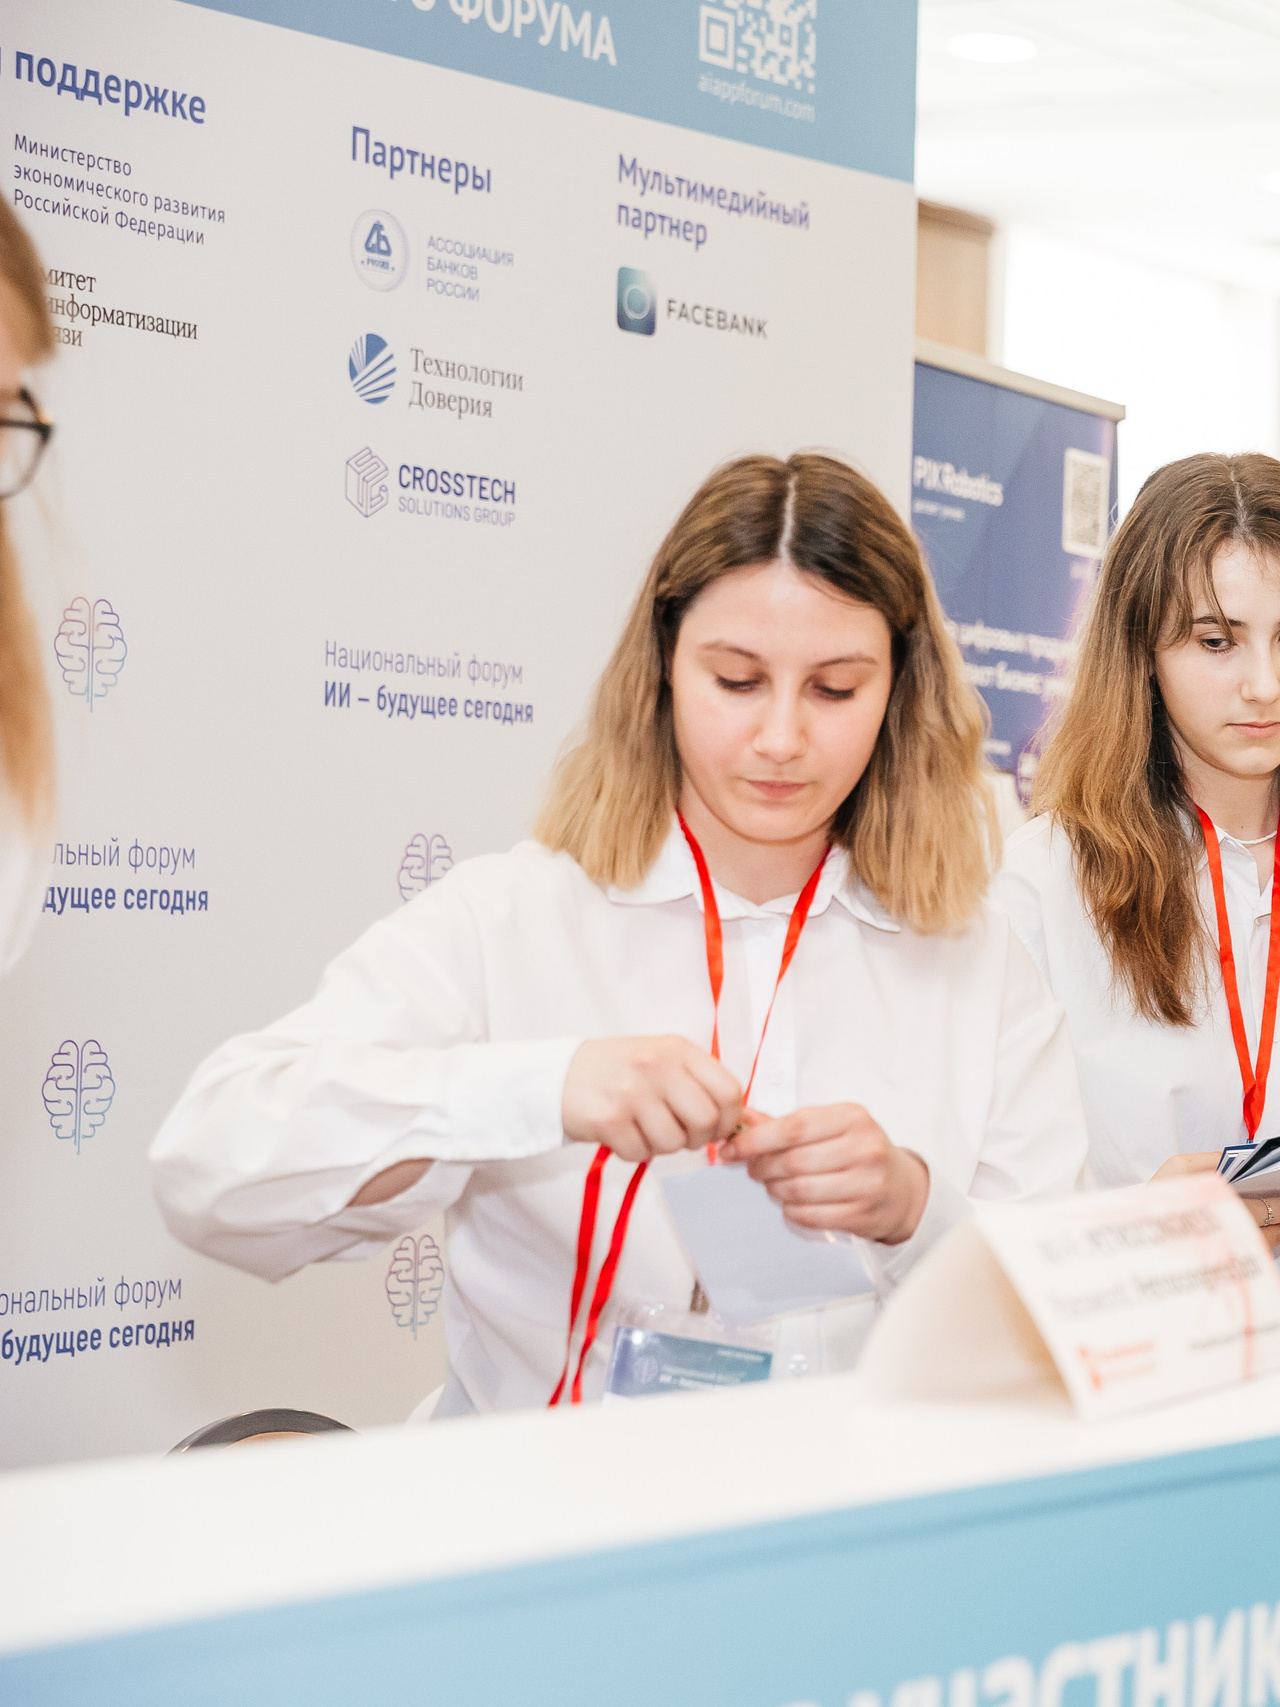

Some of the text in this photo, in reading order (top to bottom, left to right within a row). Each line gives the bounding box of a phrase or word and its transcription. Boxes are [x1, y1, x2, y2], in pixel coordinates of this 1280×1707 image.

[15, 50, 206, 125] поддержке
[13, 133, 132, 176] Министерство
[351, 125, 491, 195] Партнеры
[13, 164, 226, 224] экономического развития
[618, 153, 811, 230] Мультимедийный
[13, 188, 205, 246] Российской Федерации
[617, 203, 708, 252] партнер
[427, 235, 515, 267] АССОЦИАЦИЯ
[427, 256, 479, 281] БАНКОВ
[426, 278, 480, 301] РОССИИ
[666, 299, 769, 340] FACEBANK
[409, 347, 525, 392] Технологии
[408, 381, 494, 420] Доверия
[398, 464, 517, 506] CROSSTECH
[398, 496, 517, 528] SOLUTIONS GROUP
[324, 640, 524, 690] Национальный форум
[324, 680, 351, 708] ИИ
[376, 684, 459, 720] будущее
[463, 698, 535, 725] сегодня
[127, 838, 196, 876] форум
[123, 887, 209, 916] сегодня
[114, 1275, 183, 1312] форум
[1, 1319, 196, 1366] будущее сегодня
